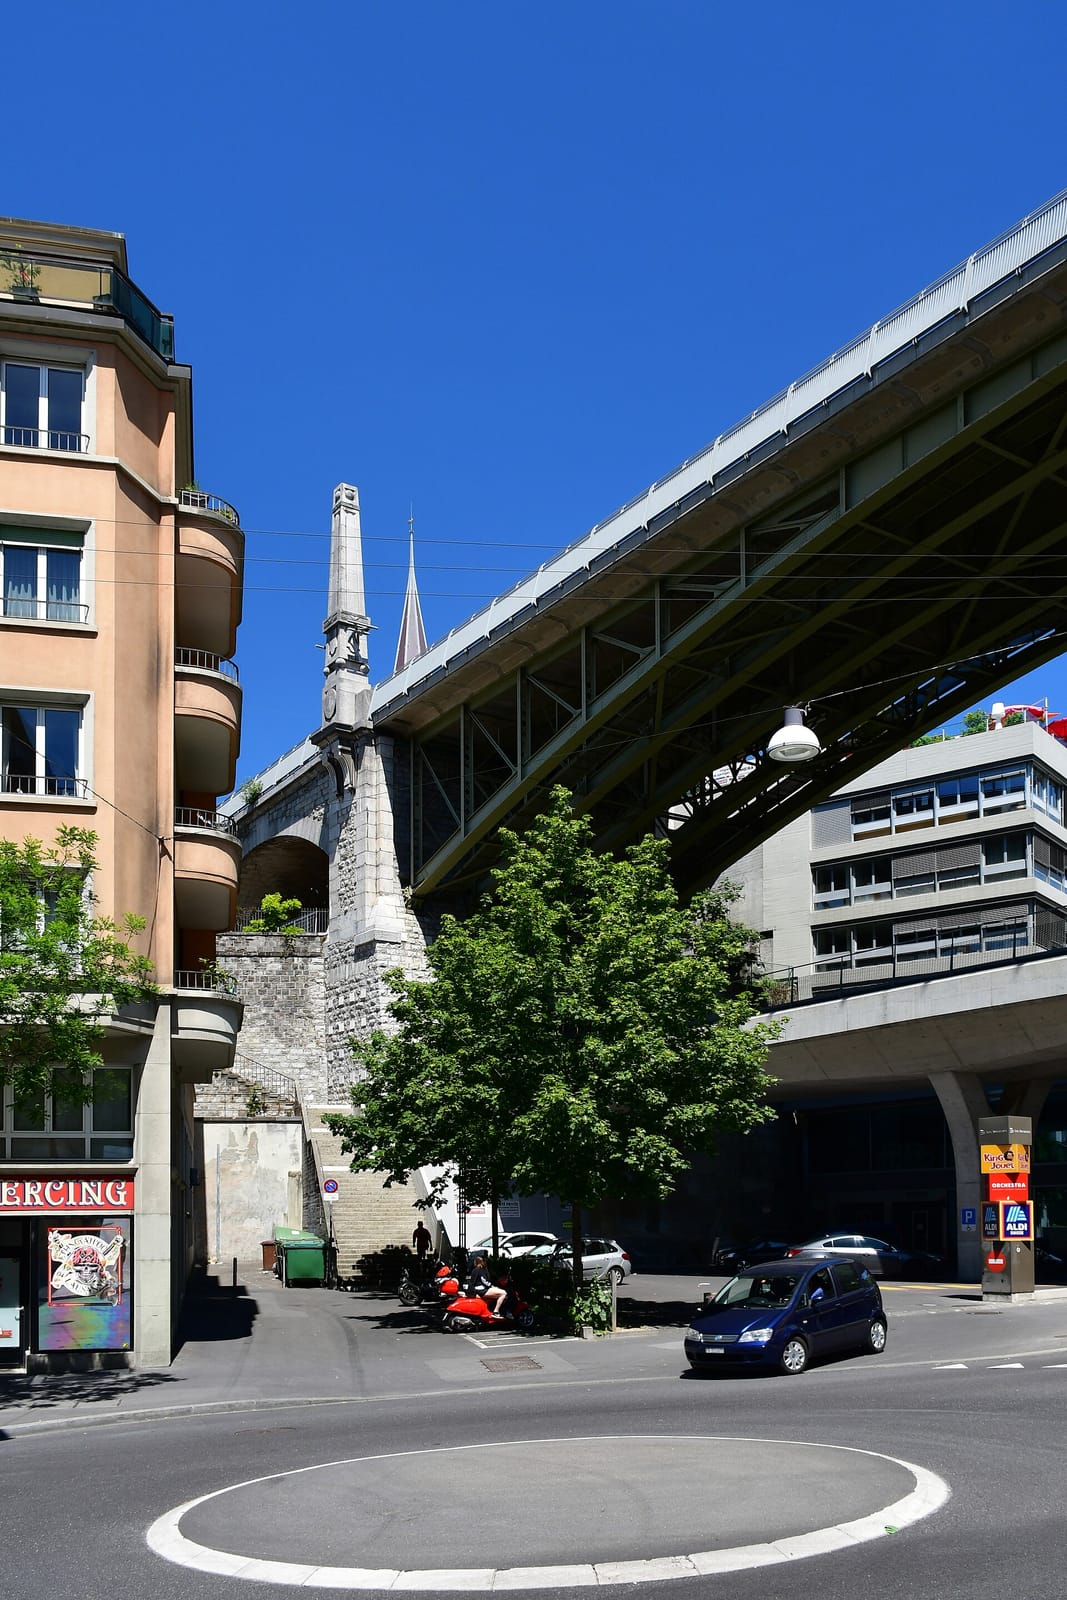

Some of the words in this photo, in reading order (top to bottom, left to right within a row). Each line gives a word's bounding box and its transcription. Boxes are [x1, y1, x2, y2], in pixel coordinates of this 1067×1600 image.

[0, 1179, 128, 1206] ERCING
[984, 1223, 998, 1231] ALDI
[1006, 1223, 1028, 1231] ALDI
